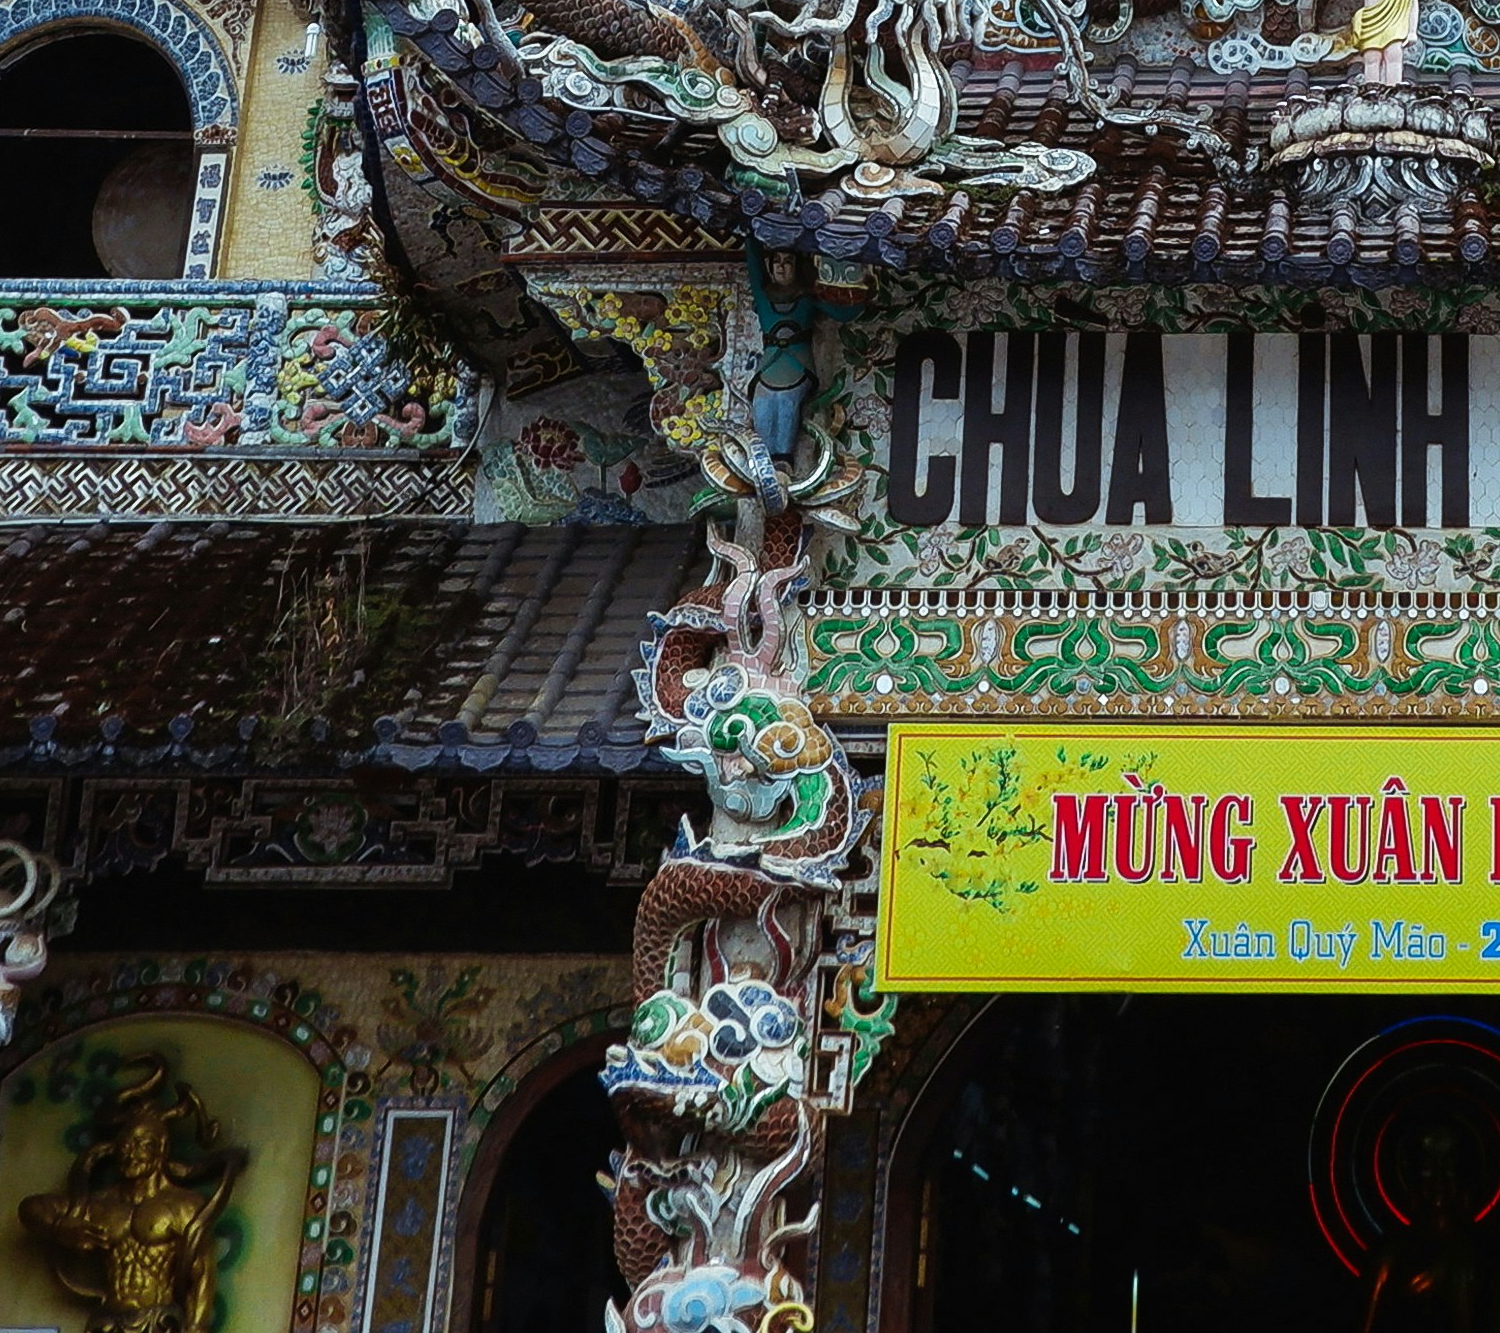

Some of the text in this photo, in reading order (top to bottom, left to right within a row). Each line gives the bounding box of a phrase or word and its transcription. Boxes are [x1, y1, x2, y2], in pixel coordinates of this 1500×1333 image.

[1224, 301, 1470, 527] LINH
[1049, 773, 1256, 883] MỪNG
[1277, 775, 1467, 884] XUÂN
[1182, 919, 1276, 959] Xuân
[1290, 919, 1357, 968] Quý
[1370, 919, 1446, 960] Mão
